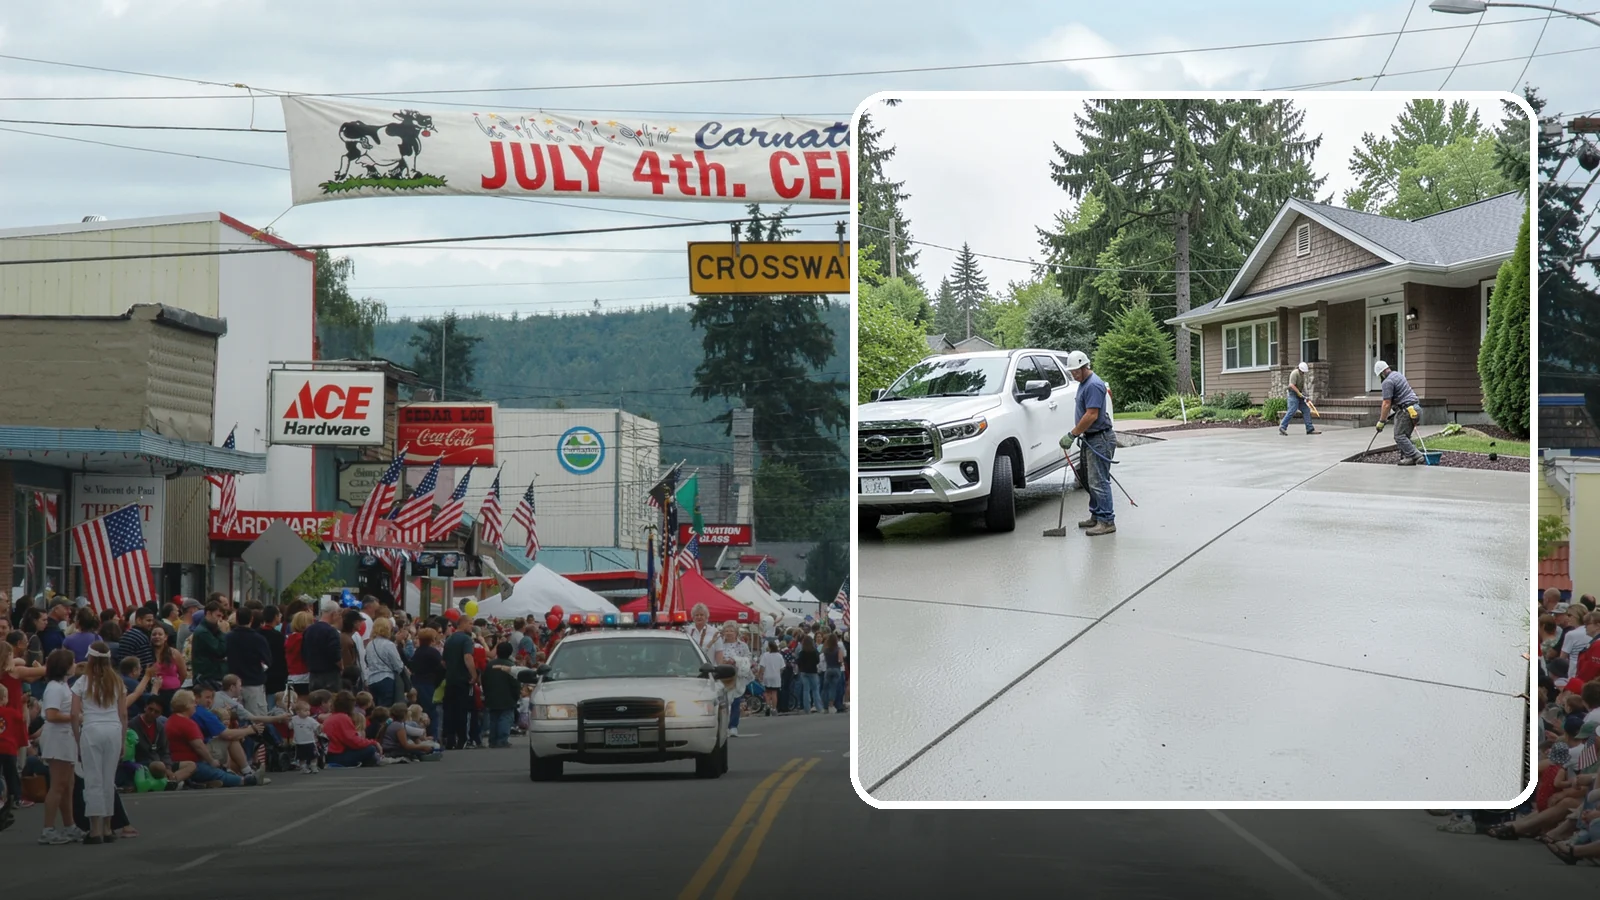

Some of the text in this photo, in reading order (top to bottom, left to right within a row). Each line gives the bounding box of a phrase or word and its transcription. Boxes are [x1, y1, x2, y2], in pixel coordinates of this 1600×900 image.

[481, 141, 605, 192] JULY
[632, 150, 746, 198] 4th.
[697, 254, 850, 280] CROSSWA
[283, 380, 374, 420] ACE
[405, 410, 452, 422] CEDAR
[283, 421, 371, 437] Hardware
[416, 428, 477, 447] Coca-Cola
[353, 467, 386, 480] Simpl
[96, 485, 125, 495] Vincent
[126, 486, 136, 495] de
[137, 486, 155, 495] Paul
[81, 503, 154, 522] THT
[688, 526, 741, 535] CRNATION
[699, 535, 730, 543] GLASS
